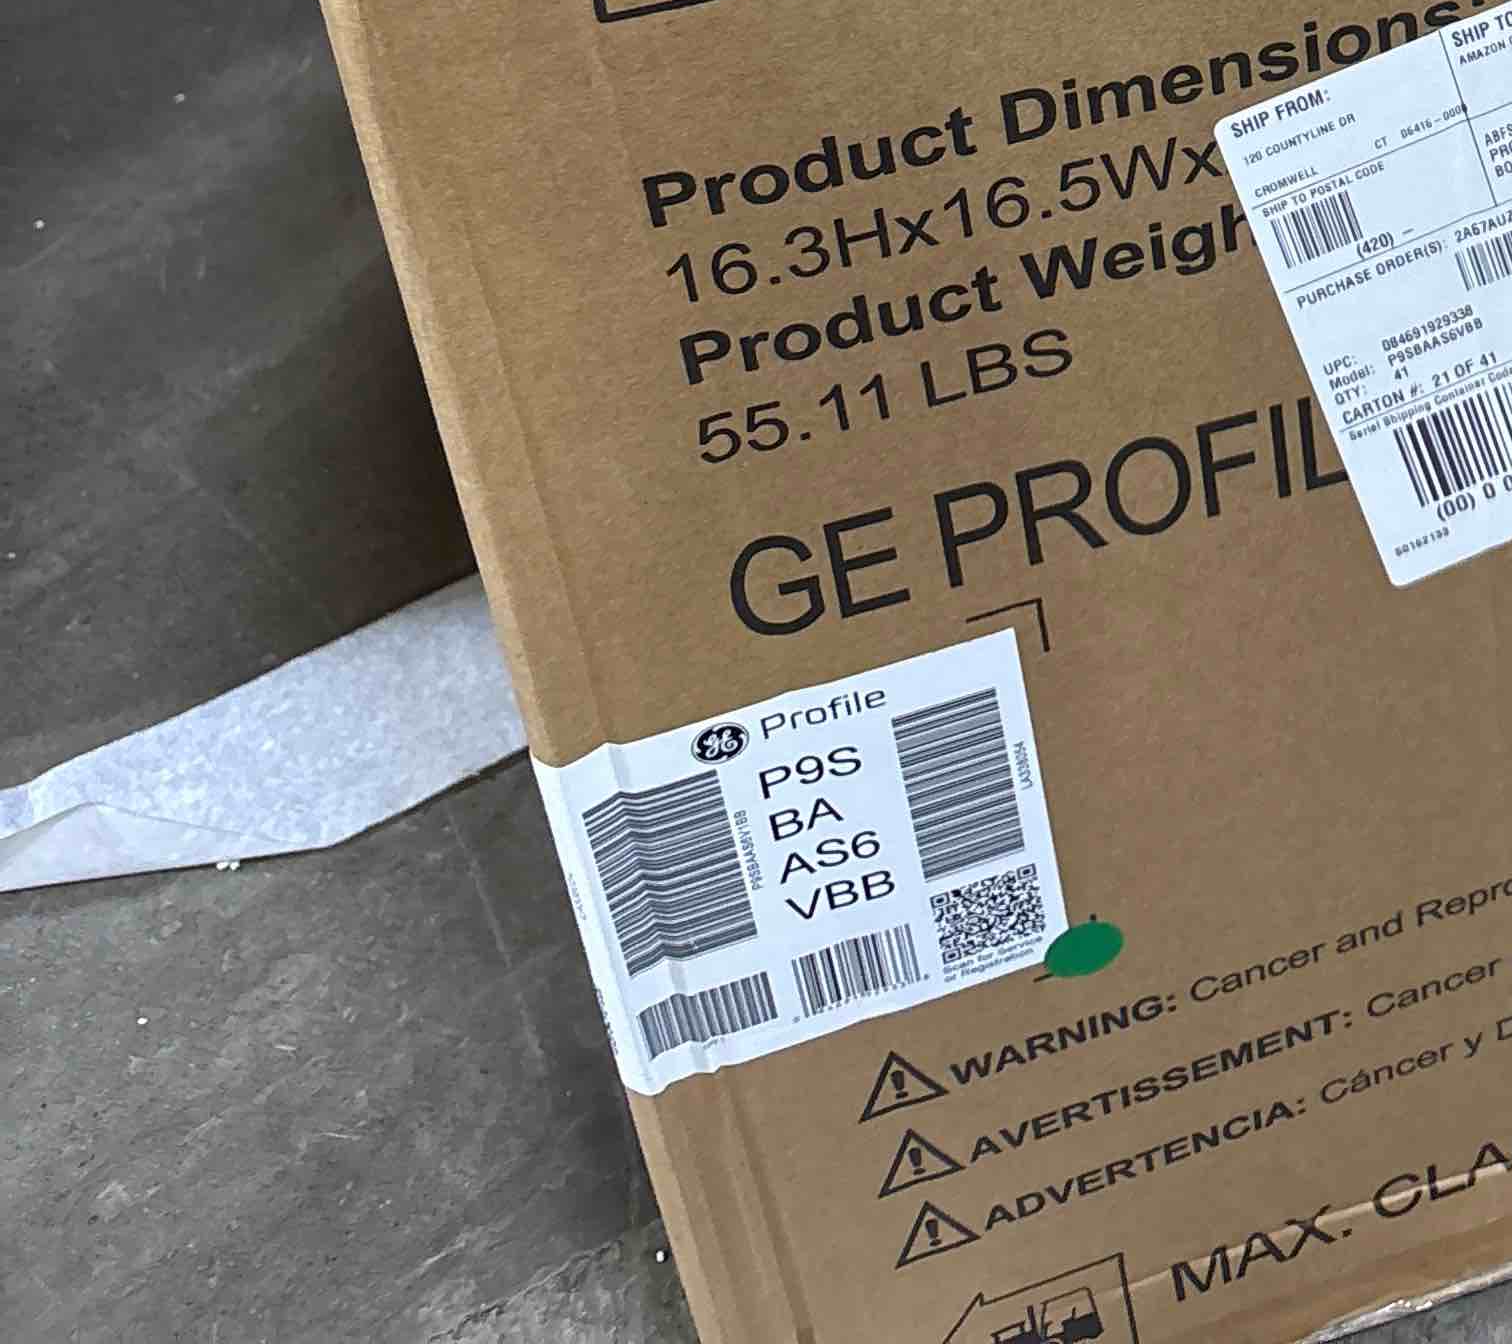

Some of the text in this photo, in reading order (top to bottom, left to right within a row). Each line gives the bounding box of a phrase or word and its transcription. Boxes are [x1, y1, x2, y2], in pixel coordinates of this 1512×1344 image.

[1451, 21, 1490, 47] SHIP
[1459, 39, 1506, 65] AMAZON
[1230, 88, 1332, 139] SHIP FROM:
[642, 106, 977, 230] Product
[1244, 150, 1262, 166] 120
[1265, 121, 1336, 158] COUNTYLINE
[1254, 166, 1319, 199] CROMWELL
[1374, 136, 1388, 150] CT
[1262, 160, 1385, 218] SHIP TO POSTAL CODE
[667, 136, 1230, 306] 16.3Hx16.5Wx
[1356, 231, 1394, 259] (420)
[678, 205, 1256, 386] Product Weigh
[1296, 268, 1372, 310] PURCHASE
[1376, 239, 1449, 277] ORDER(S):
[1323, 303, 1474, 376] UPC: 084691929338
[697, 327, 1074, 464] 55.11 LBS
[1329, 362, 1376, 391] Model:
[1334, 366, 1410, 405] QTY: 41
[1342, 351, 1497, 426] CARTON #: 21 OF 41
[728, 397, 1349, 636] GE PROFIL
[1436, 493, 1477, 522] (00)
[1483, 481, 1497, 500] 0
[759, 684, 888, 740] Profile
[758, 746, 863, 800] P9S
[768, 797, 844, 841] BA
[779, 830, 881, 885] AS6
[785, 869, 896, 921] VBB
[949, 989, 1178, 1088] WARNING:
[1191, 941, 1326, 1004] Cancer
[1336, 914, 1404, 955] and
[967, 1008, 1353, 1165] AVERTISSEMENT:
[1367, 958, 1503, 1019] Cancer
[984, 1096, 1306, 1232] ADVERTENCIA:
[1320, 1040, 1453, 1108] Cáncer
[1463, 1029, 1483, 1062] y
[1172, 1201, 1353, 1305] MAX.
